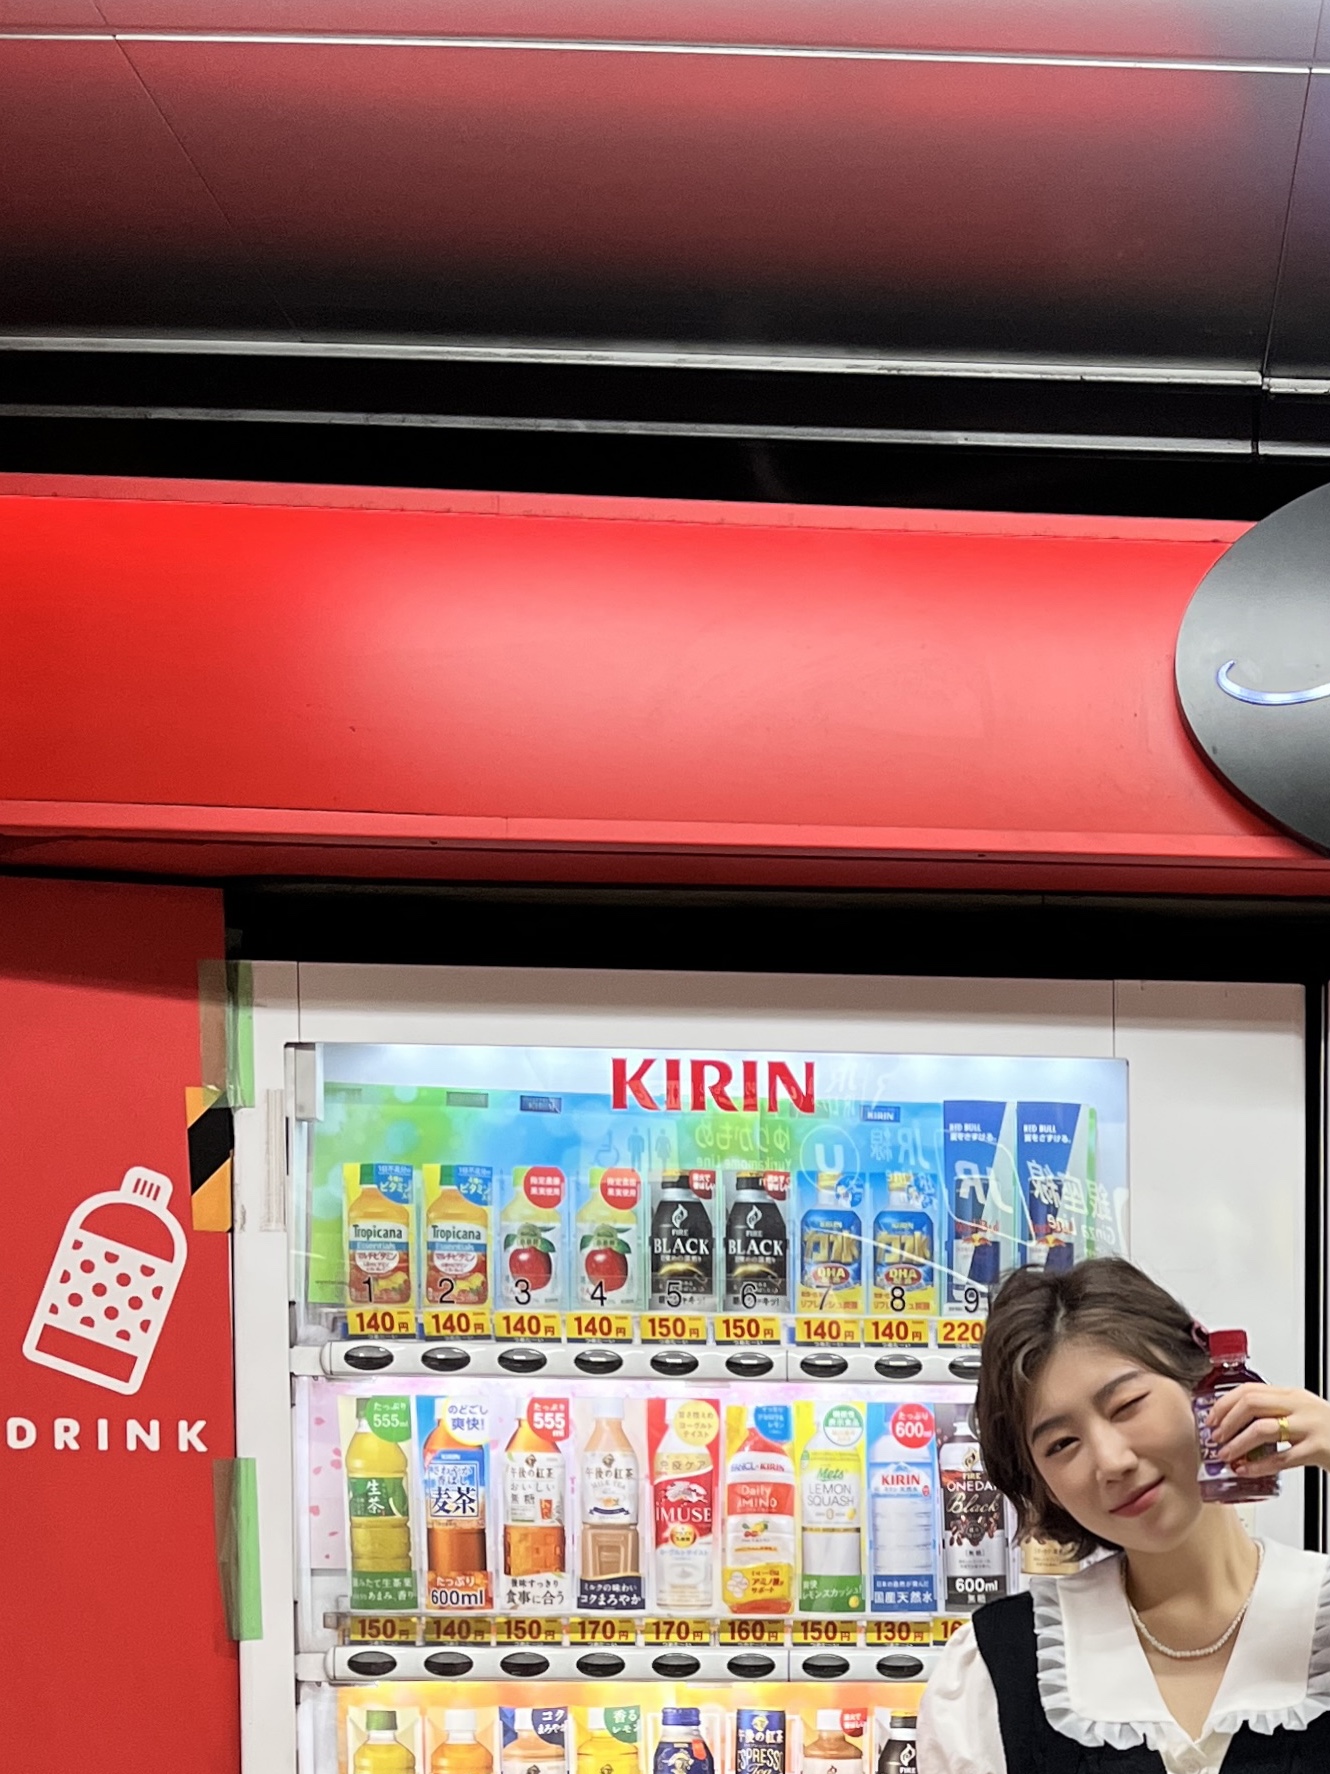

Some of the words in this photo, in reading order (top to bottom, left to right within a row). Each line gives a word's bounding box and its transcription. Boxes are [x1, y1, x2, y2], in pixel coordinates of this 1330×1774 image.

[612, 1058, 815, 1114] KIRIN
[867, 1112, 894, 1120] KIRIN
[353, 1225, 402, 1239] Tropicana
[432, 1225, 481, 1240] Tropicana
[653, 1238, 709, 1254] BLACK
[728, 1239, 783, 1255] BLACK
[363, 1277, 372, 1302] 1
[439, 1278, 455, 1303] 2
[515, 1279, 531, 1305] 3
[590, 1281, 607, 1306] 4
[667, 1282, 682, 1307] 5
[741, 1283, 756, 1309] 6
[816, 1285, 831, 1310] 7
[890, 1286, 906, 1311] 8
[964, 1288, 979, 1312] 9
[449, 1405, 488, 1414] のどごし
[533, 1413, 565, 1429] 555
[6, 1417, 208, 1452] DRINK
[511, 1468, 554, 1479] 午後の紅茶
[585, 1468, 634, 1479] 午後の紅茶
[882, 1475, 920, 1486] KIRIN
[963, 1472, 981, 1480] FIRE
[741, 1485, 771, 1497] Daily
[809, 1484, 851, 1494] LEMON
[366, 1480, 384, 1514] 生茶
[432, 1488, 476, 1514] 麦茶
[807, 1495, 854, 1506] SQUASH
[946, 1492, 999, 1514] Black
[436, 1577, 474, 1586] たっぷり
[955, 1578, 997, 1592] 600ml
[431, 1590, 483, 1605] 600ml
[506, 1590, 564, 1605] 食事に合う
[580, 1594, 641, 1606] コクまろやか
[874, 1591, 933, 1603] 国産天然水
[542, 1712, 565, 1720] コク
[613, 1710, 637, 1723] 香る
[739, 1729, 783, 1743] 午後の紅茶
